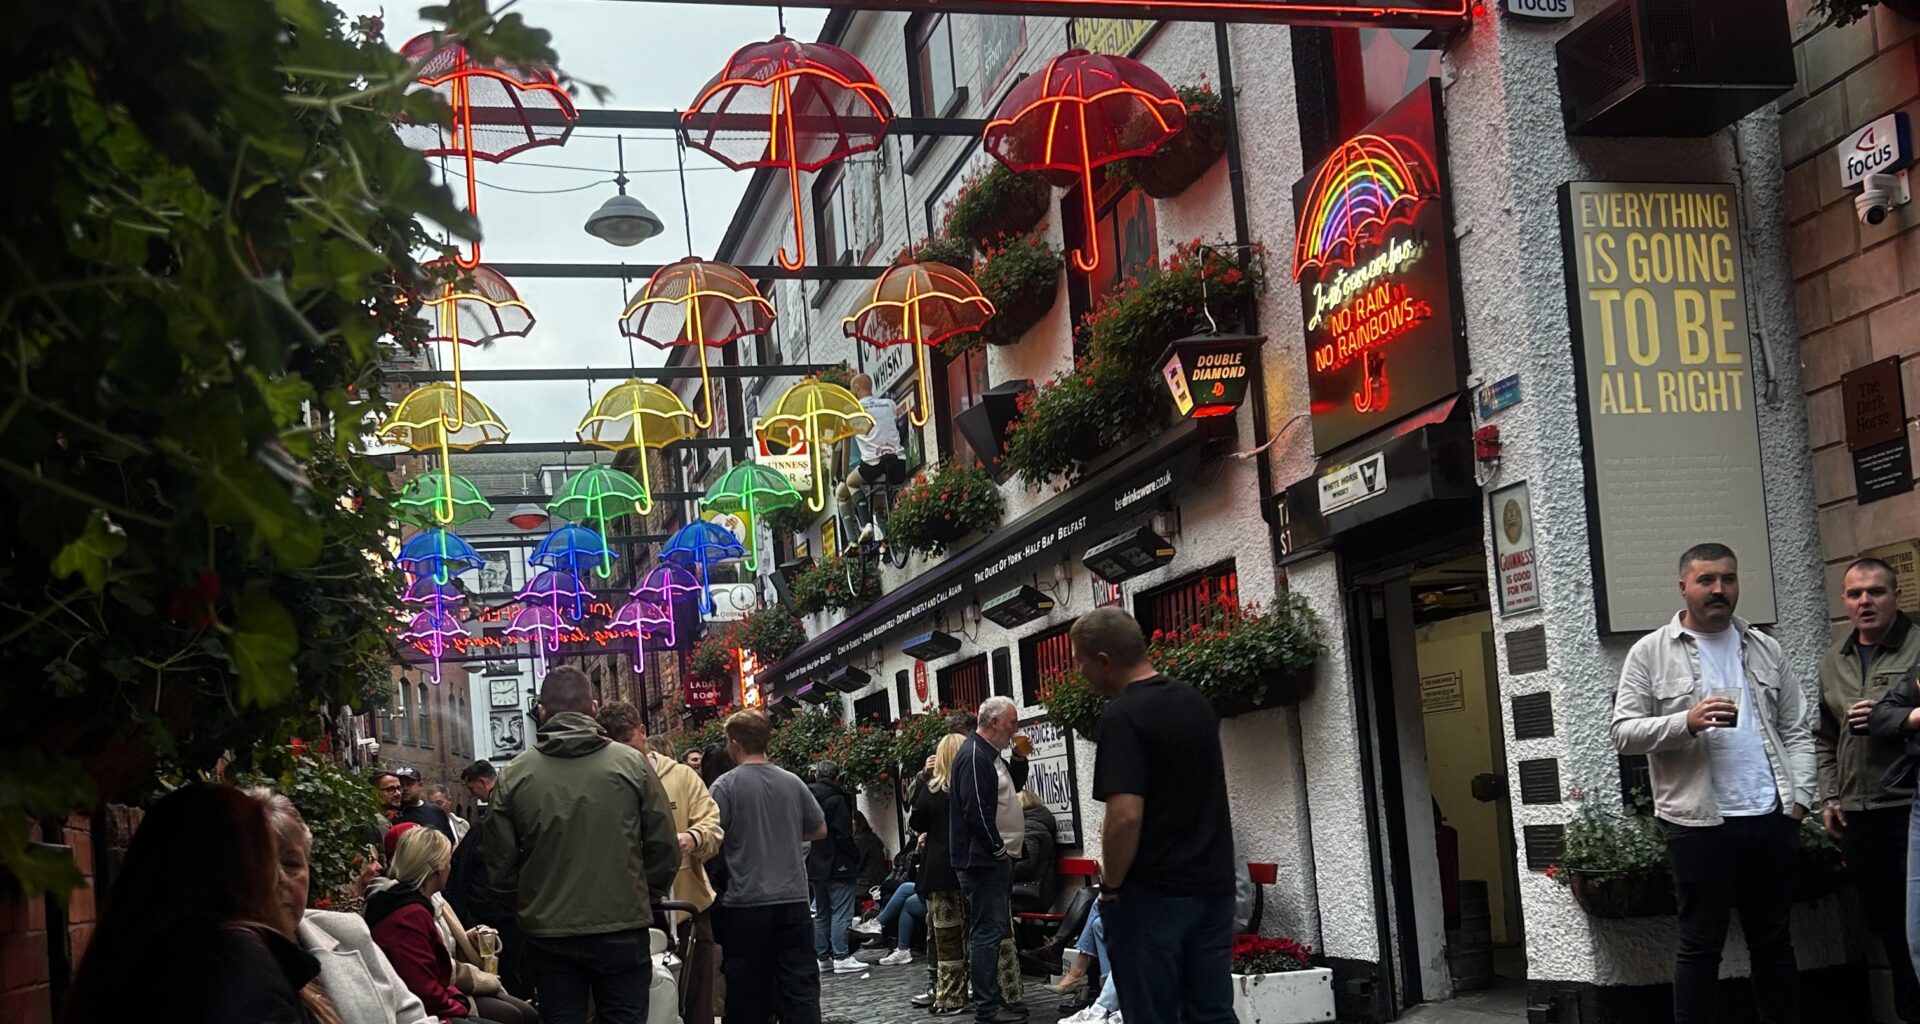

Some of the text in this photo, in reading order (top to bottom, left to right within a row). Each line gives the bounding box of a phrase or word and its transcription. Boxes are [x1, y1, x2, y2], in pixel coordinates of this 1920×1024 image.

[1847, 144, 1891, 180] focus
[1580, 192, 1729, 229] EVERYTHING
[1584, 232, 1734, 284] IS GOING
[1331, 282, 1390, 336] NO RAIN
[1589, 288, 1743, 366] TO BE
[1315, 298, 1413, 371] NO RAINBOWS
[874, 344, 903, 391] WHISKY
[1192, 366, 1246, 380] DIAMOND
[1197, 353, 1242, 367] DOUBLE
[1600, 370, 1743, 414] ALL RIGHT
[1857, 412, 1889, 432] Horse
[1115, 469, 1172, 511] bedrinkaware.co.uk
[974, 573, 985, 584] THE
[984, 563, 999, 579] DUKE
[1007, 551, 1022, 566] YORK
[1058, 517, 1087, 540] BELFAST
[1500, 548, 1534, 571] GUINNESS
[1508, 581, 1533, 595] FOR YOU
[1513, 570, 1531, 583] GOOD
[1034, 761, 1071, 811] Whisky
